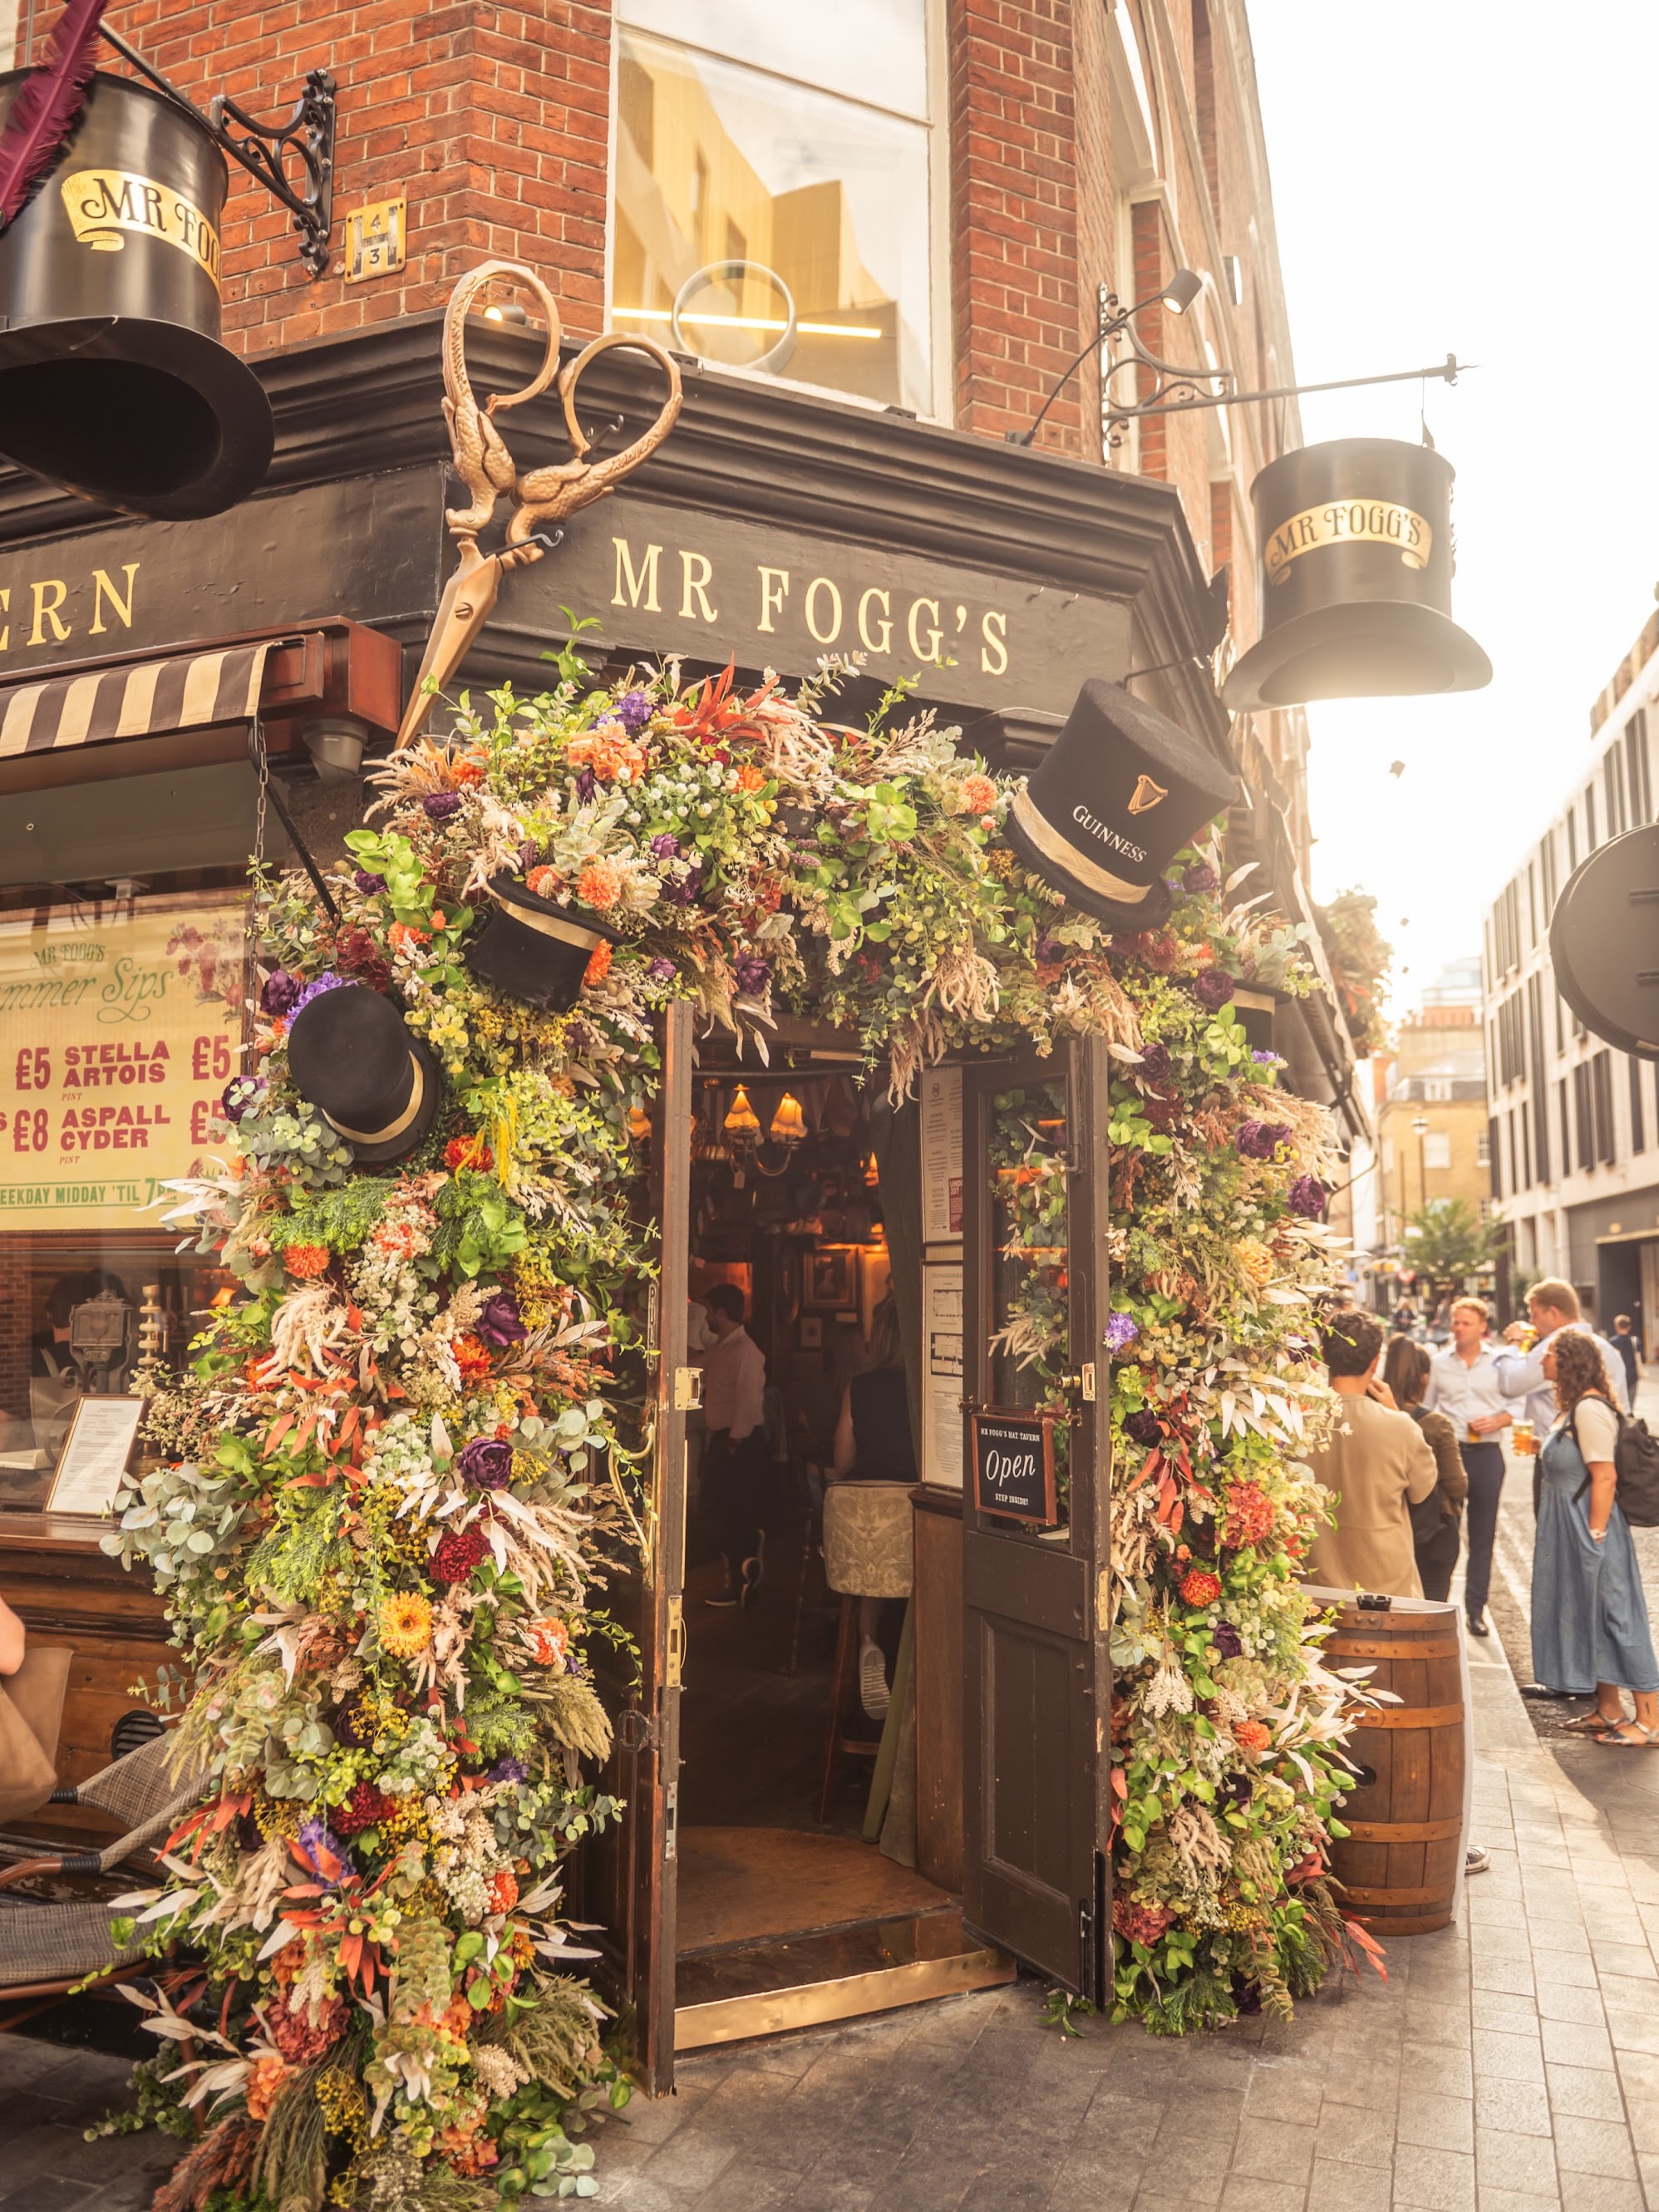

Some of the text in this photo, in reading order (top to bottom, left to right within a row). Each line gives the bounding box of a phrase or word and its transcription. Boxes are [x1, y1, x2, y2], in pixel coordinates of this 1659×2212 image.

[81, 178, 167, 232] MR
[370, 214, 381, 229] 4
[369, 248, 380, 264] 3
[1270, 505, 1421, 567] MR FOGG'S
[611, 536, 1009, 676] MR FOGG'S
[1072, 805, 1147, 863] GUINNESS
[30, 943, 106, 970] MR FOGG'S
[96, 957, 175, 1023] Sips
[64, 1040, 170, 1066] STELLA
[192, 1035, 232, 1081] £5
[16, 1047, 51, 1091] £5
[62, 1062, 165, 1088] ARTOIS
[62, 1092, 82, 1101] PINT
[61, 1104, 171, 1128] ASPALL
[13, 1108, 48, 1152] £8
[60, 1127, 149, 1151] CYDER
[59, 1155, 81, 1165] PINT
[56, 1185, 106, 1204] MIDDAY
[113, 1185, 140, 1202] 'TIL
[981, 1427, 1041, 1442] MR FOGG'S HAT TAVERN
[986, 1450, 1036, 1487] Open
[995, 1493, 1029, 1505] STEP INSIDE!
